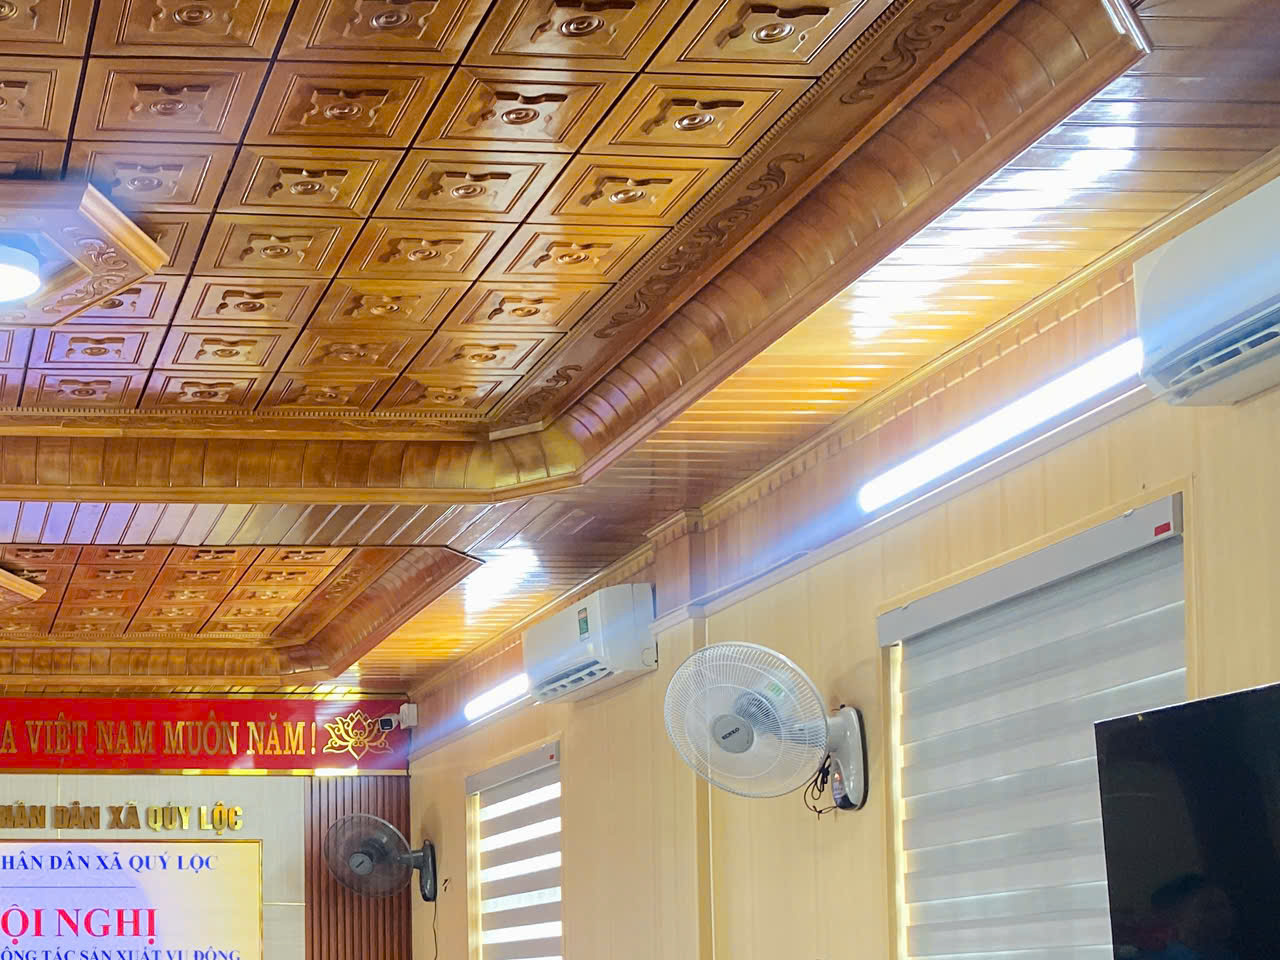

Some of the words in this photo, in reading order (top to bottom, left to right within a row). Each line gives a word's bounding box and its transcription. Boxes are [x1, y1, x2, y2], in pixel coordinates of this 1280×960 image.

[95, 721, 155, 756] NAM
[163, 709, 239, 756] MUÔN
[54, 801, 101, 830] DÂN
[107, 800, 141, 830] XÃ
[199, 800, 244, 836] LỘC
[49, 850, 90, 870] DÂN
[96, 851, 123, 870] XÃ
[128, 851, 171, 873] QUÝ
[177, 852, 218, 873] LỘC
[55, 908, 158, 945] NGHỊ
